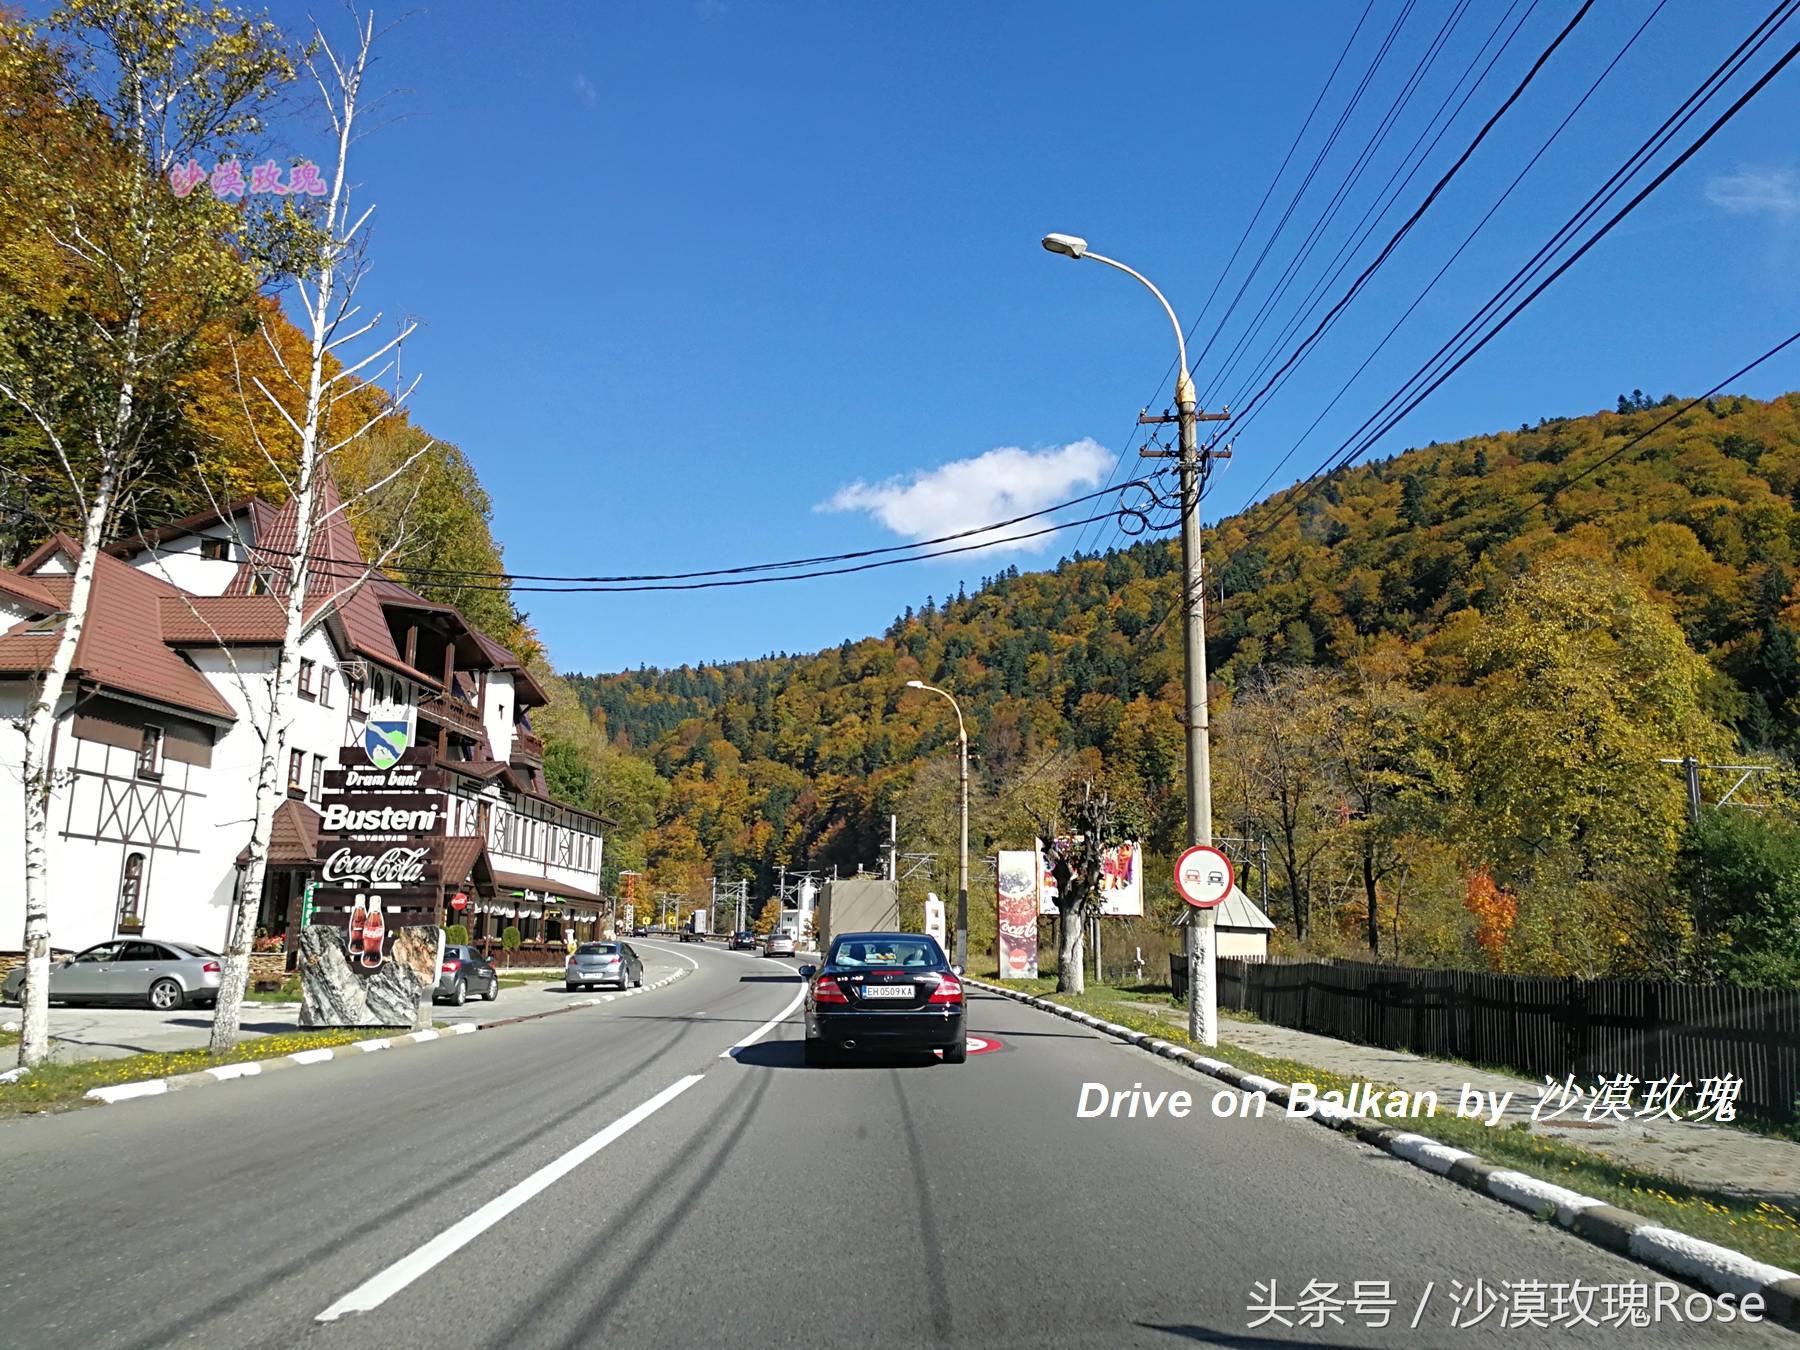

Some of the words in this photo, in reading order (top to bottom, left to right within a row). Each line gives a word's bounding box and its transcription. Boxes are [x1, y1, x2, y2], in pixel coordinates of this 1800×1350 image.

[345, 771, 386, 786] Drum
[388, 770, 422, 786] bun!
[323, 804, 439, 830] Busteni
